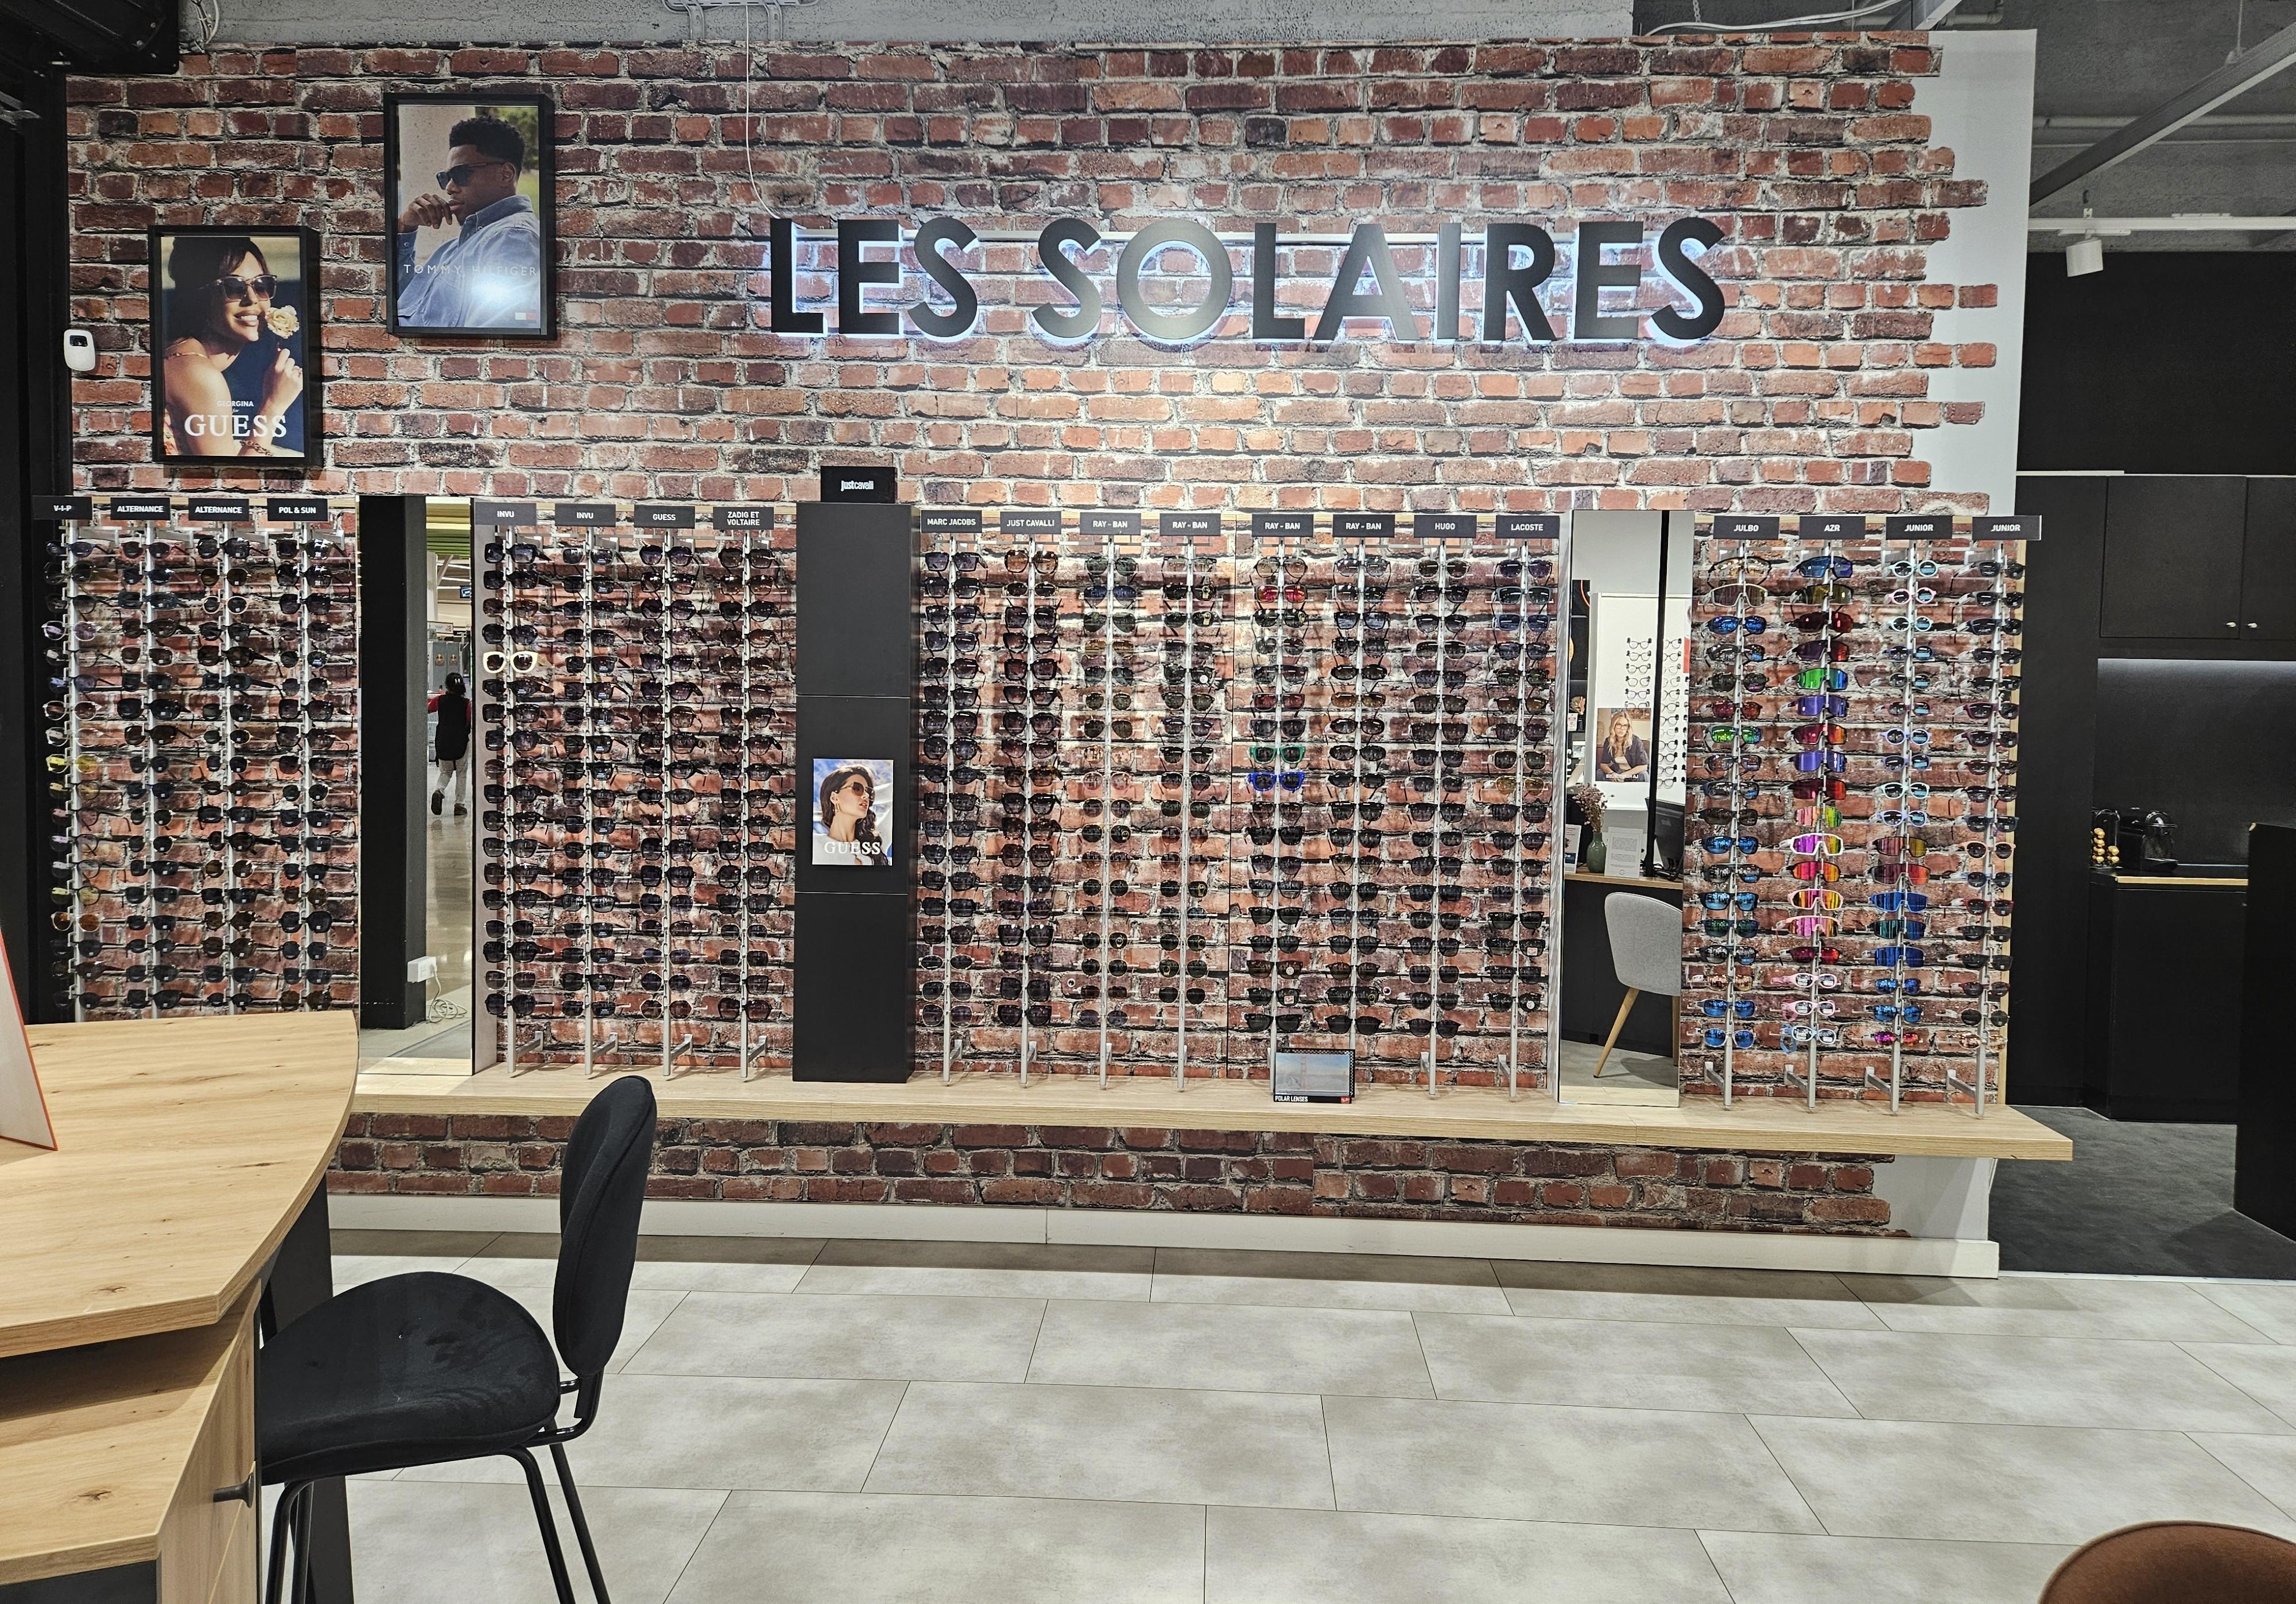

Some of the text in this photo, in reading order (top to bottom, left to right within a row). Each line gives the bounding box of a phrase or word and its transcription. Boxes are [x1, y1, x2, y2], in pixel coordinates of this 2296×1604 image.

[404, 264, 537, 277] TOMMY HILFIGER
[770, 216, 1726, 343] LES SOLAIRES
[184, 414, 287, 438] GUESS
[195, 506, 243, 514] ALTERNANCE
[652, 513, 676, 521] GUESS
[927, 518, 947, 526] MARC
[1006, 519, 1055, 527] JUST CAVALLI
[1092, 520, 1107, 528] RAY
[1265, 522, 1279, 530] RAY
[1434, 522, 1456, 530] HUGO
[1733, 524, 1759, 532] JULBO
[1903, 524, 1934, 532] JUNIOR
[824, 842, 881, 855] GUESS
